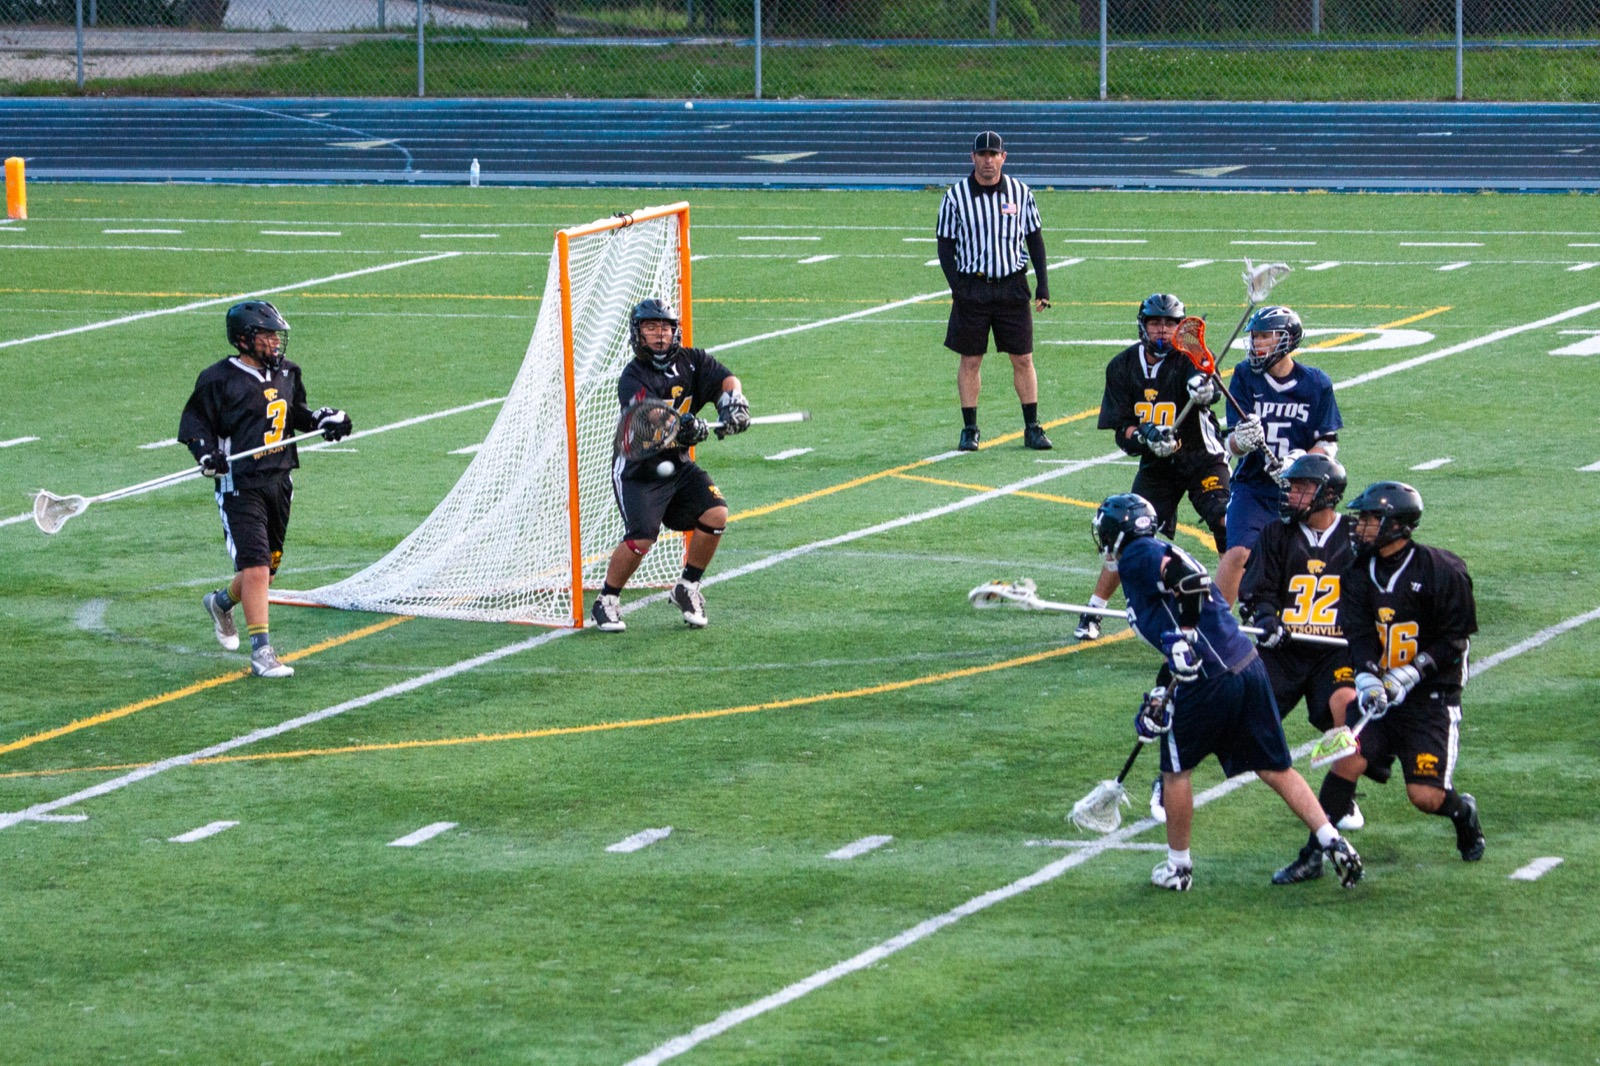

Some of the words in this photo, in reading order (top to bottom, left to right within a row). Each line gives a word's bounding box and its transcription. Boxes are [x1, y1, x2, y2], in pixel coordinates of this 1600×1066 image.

[264, 398, 288, 446] 3
[1253, 401, 1310, 423] APTOS
[1264, 421, 1292, 464] 5
[1281, 574, 1341, 625] 32
